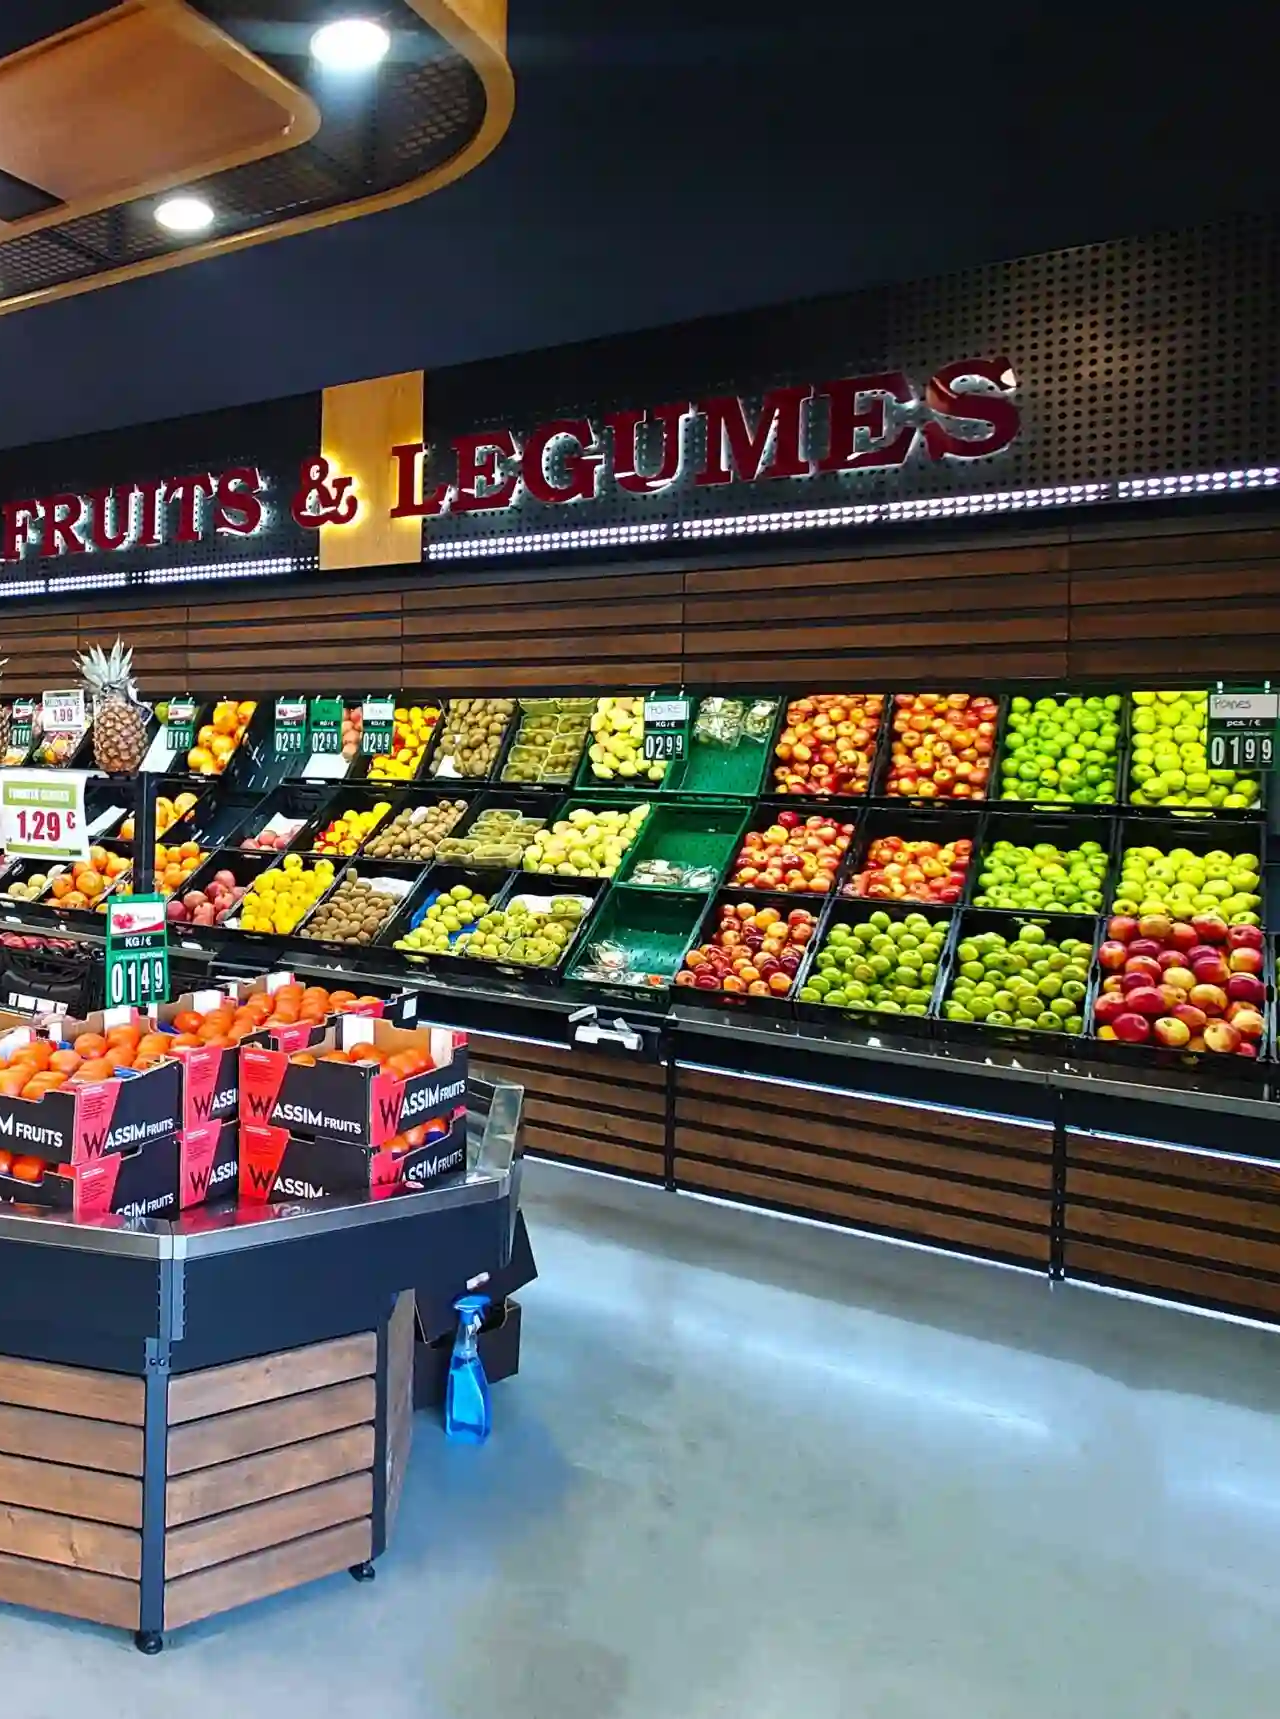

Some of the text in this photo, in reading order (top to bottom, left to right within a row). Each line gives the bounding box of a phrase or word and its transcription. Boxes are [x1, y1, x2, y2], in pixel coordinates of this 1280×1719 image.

[2, 357, 1023, 564] FRUITS & LEGUMES
[312, 732, 338, 752] 0299
[363, 732, 390, 752] 0299
[645, 735, 683, 759] 0299
[1211, 736, 1272, 765] 0199
[17, 810, 60, 842] 1,29
[111, 961, 163, 1004] 0149
[248, 1093, 362, 1135] WASSIM FRUITS
[380, 1079, 466, 1133] WASSIM FRUITS
[16, 1122, 63, 1148] FRUITS
[83, 1118, 174, 1158] WASSIM FRUITS
[438, 1149, 463, 1173] FRUITS
[248, 1163, 323, 1199] WASSIM
[147, 1193, 174, 1213] FRUITS
